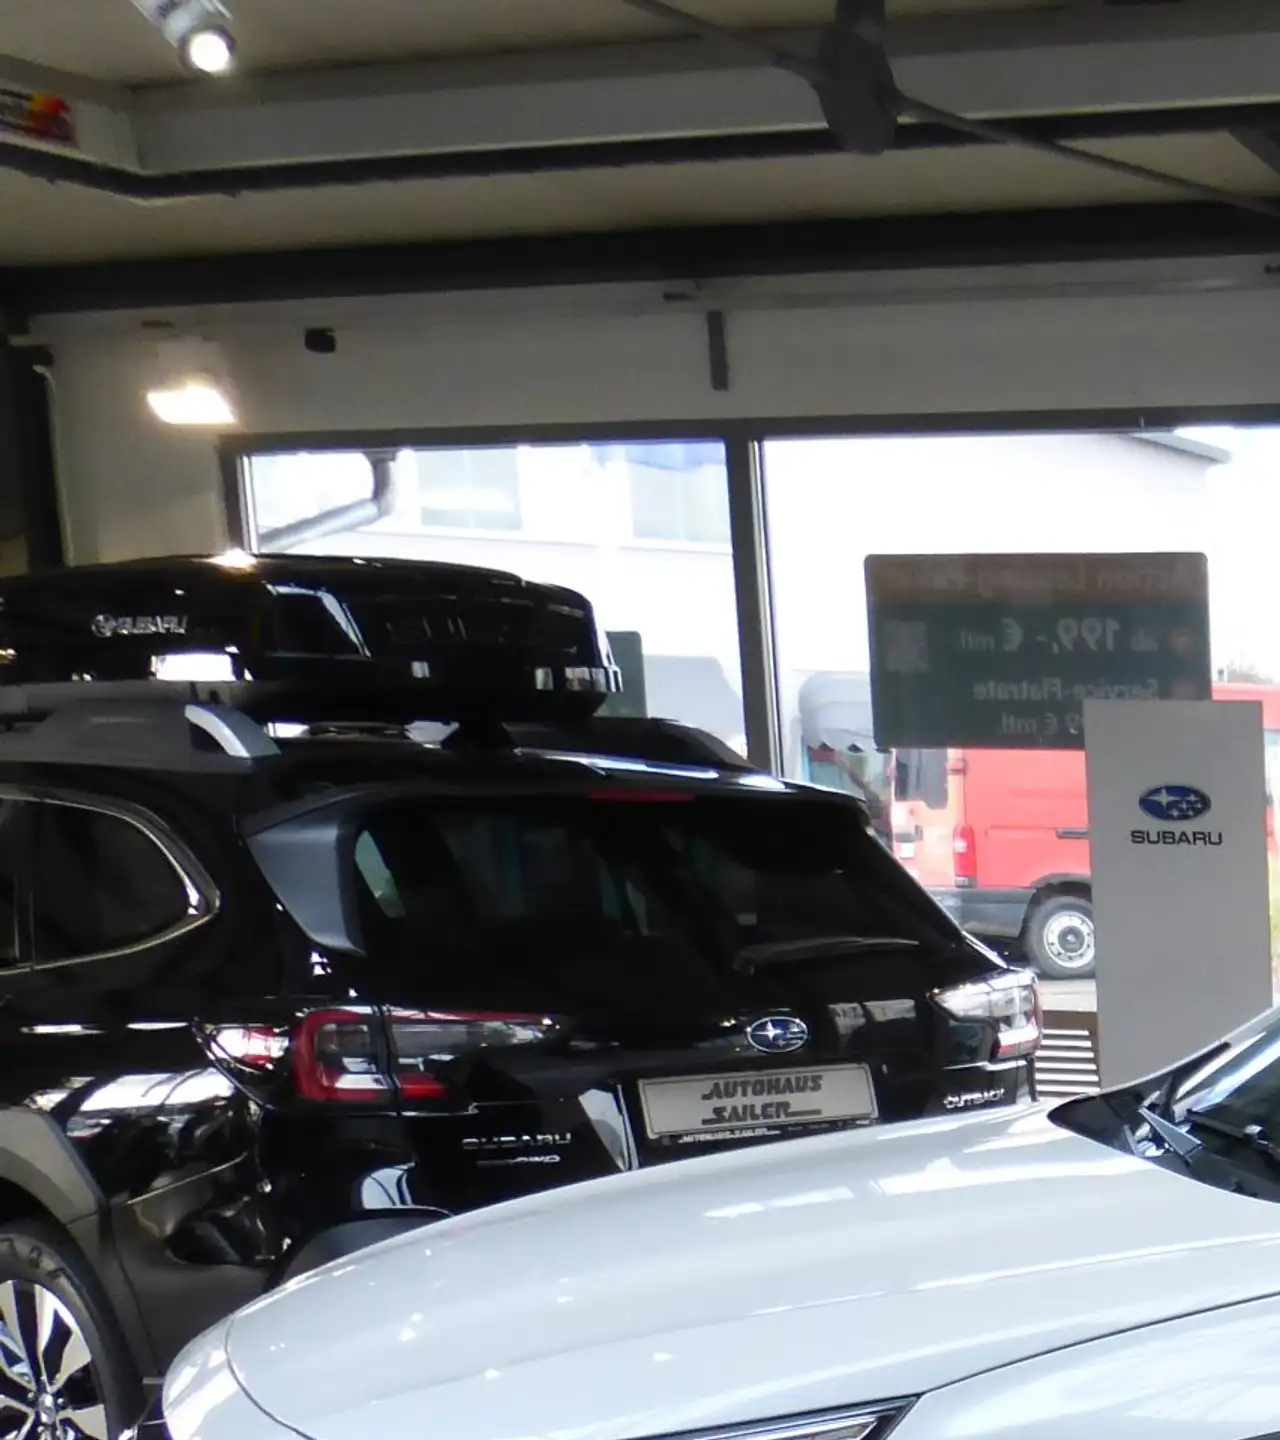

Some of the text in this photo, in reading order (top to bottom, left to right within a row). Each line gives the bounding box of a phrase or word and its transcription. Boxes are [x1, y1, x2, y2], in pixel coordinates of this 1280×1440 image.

[1130, 829, 1224, 847] SUBARU
[701, 1074, 824, 1101] AUTOHAUS
[701, 1101, 822, 1126] SAILER
